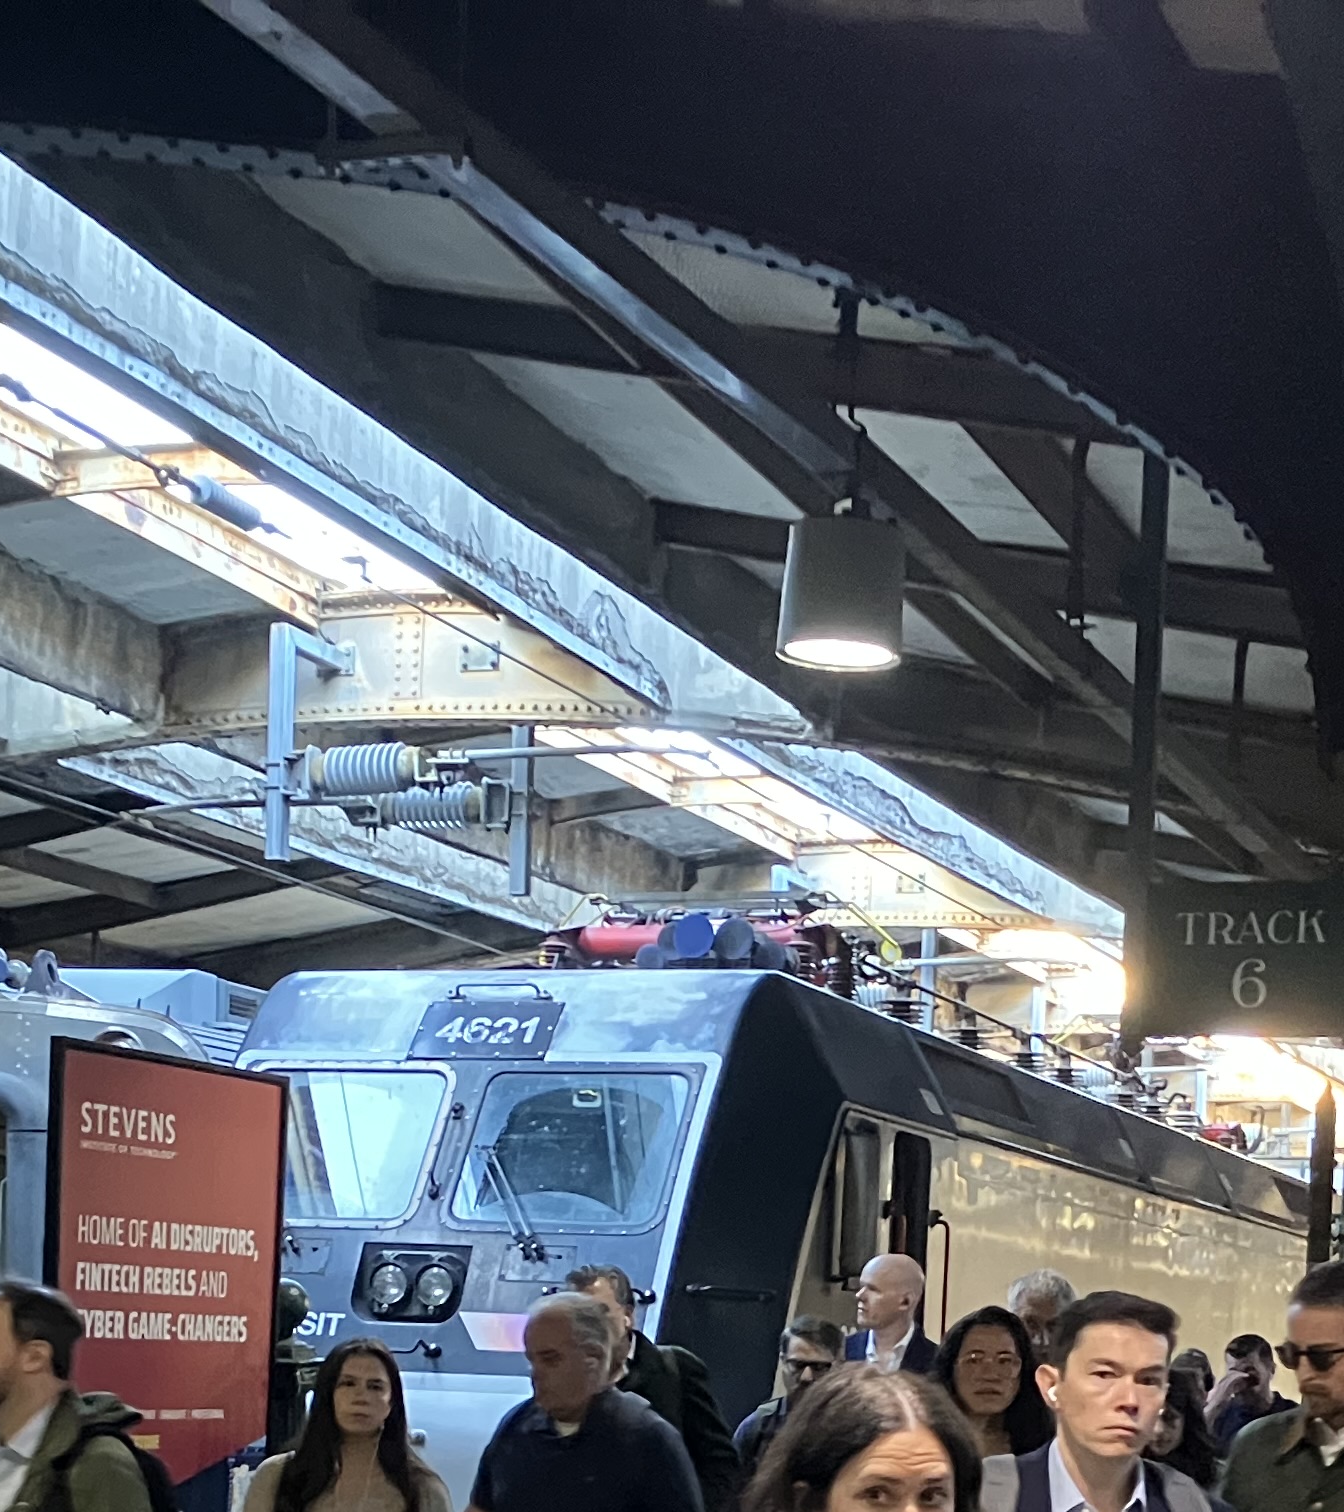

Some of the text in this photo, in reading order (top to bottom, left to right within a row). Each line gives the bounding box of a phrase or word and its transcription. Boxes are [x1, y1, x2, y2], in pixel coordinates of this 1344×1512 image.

[1176, 909, 1325, 945] TRACK
[1232, 958, 1267, 1008] 6
[435, 1016, 541, 1044] 4621
[80, 1101, 176, 1144] STEVENS
[78, 1214, 259, 1262] HOME OF AI DISRUPTORS,
[76, 1262, 228, 1298] FINTECH REBELS AND
[128, 1311, 248, 1343] GAME-CHANGERS
[293, 1311, 346, 1336] SIT
